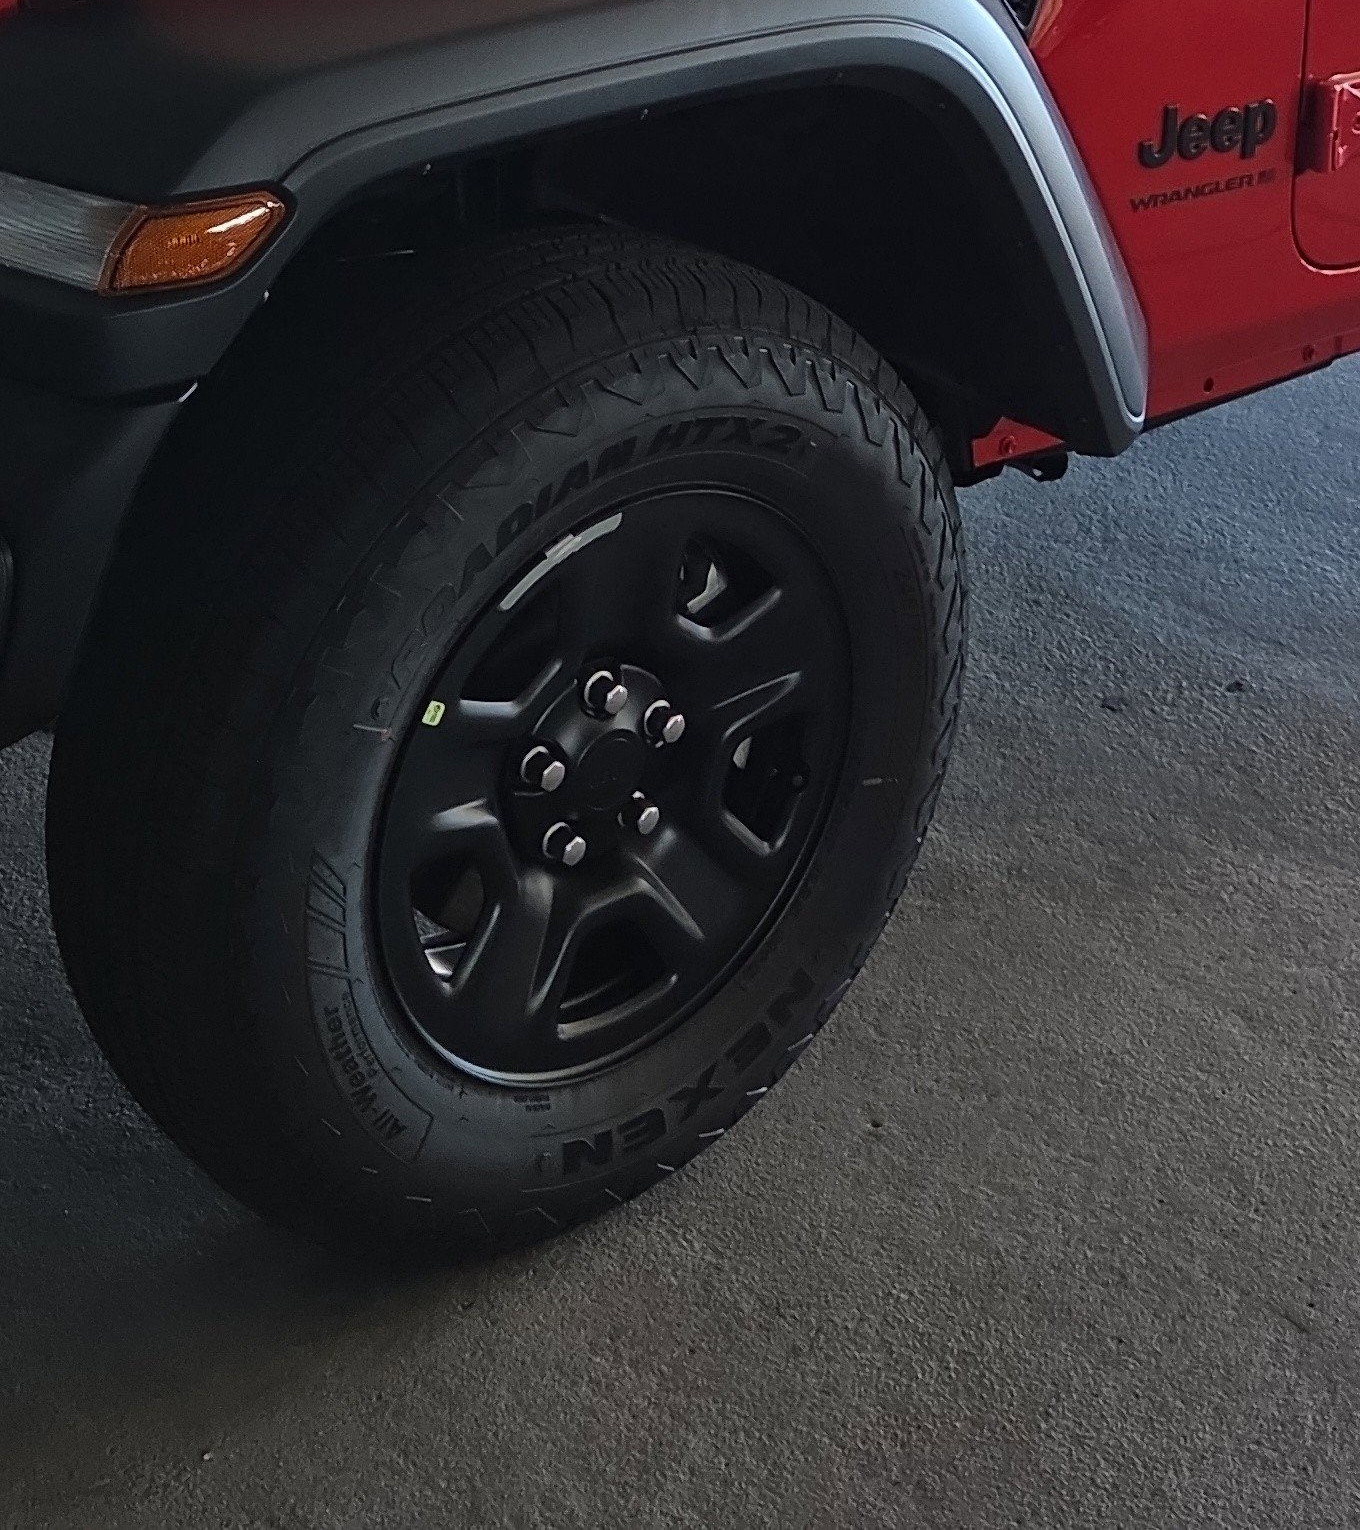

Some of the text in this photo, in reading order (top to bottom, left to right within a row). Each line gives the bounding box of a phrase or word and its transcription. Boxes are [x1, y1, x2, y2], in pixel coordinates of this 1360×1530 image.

[1138, 98, 1277, 169] Jeep
[1129, 175, 1255, 212] WRANGLER
[648, 417, 803, 456] HTX2
[323, 1006, 407, 1142] All-Weather
[561, 967, 815, 1175] NEXEN
